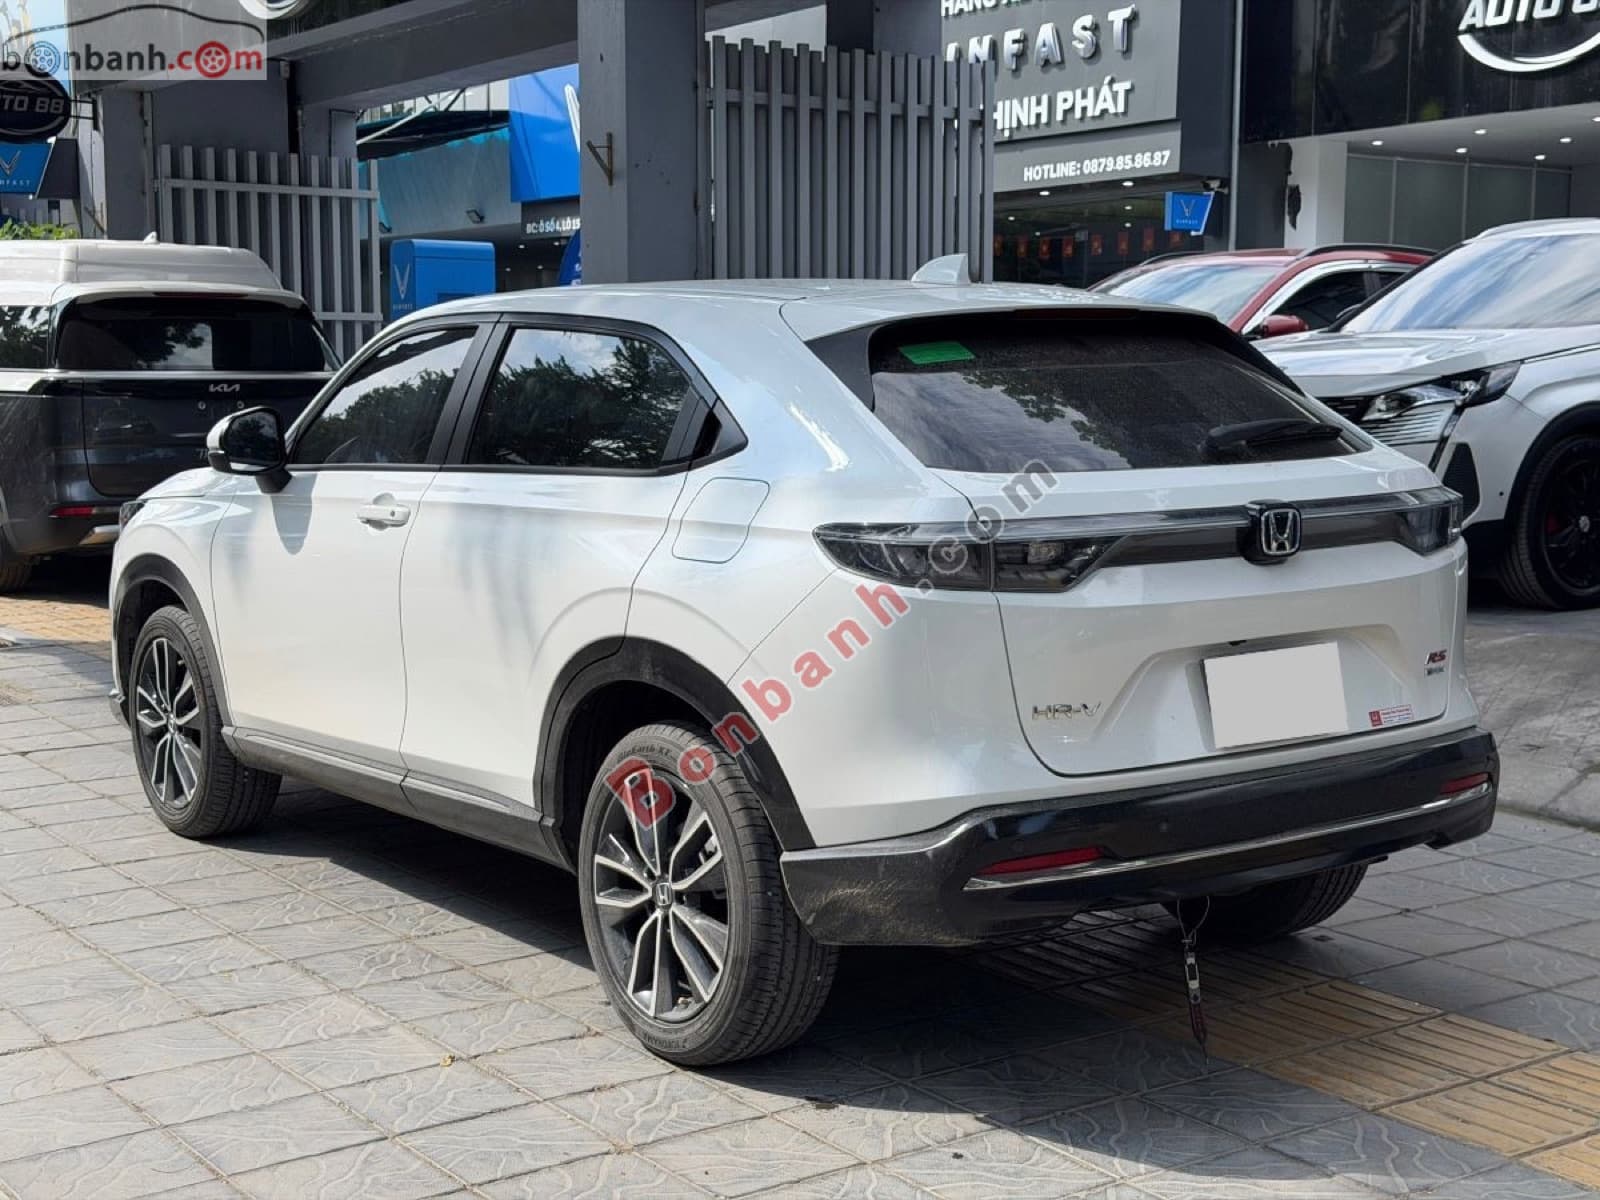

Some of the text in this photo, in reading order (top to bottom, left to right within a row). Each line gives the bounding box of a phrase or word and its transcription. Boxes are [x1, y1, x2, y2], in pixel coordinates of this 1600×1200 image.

[1056, 75, 1132, 121] PHÁT
[1023, 149, 1170, 182] HOTLINE: 0879.85.86.87
[1032, 701, 1101, 720] HR-V
